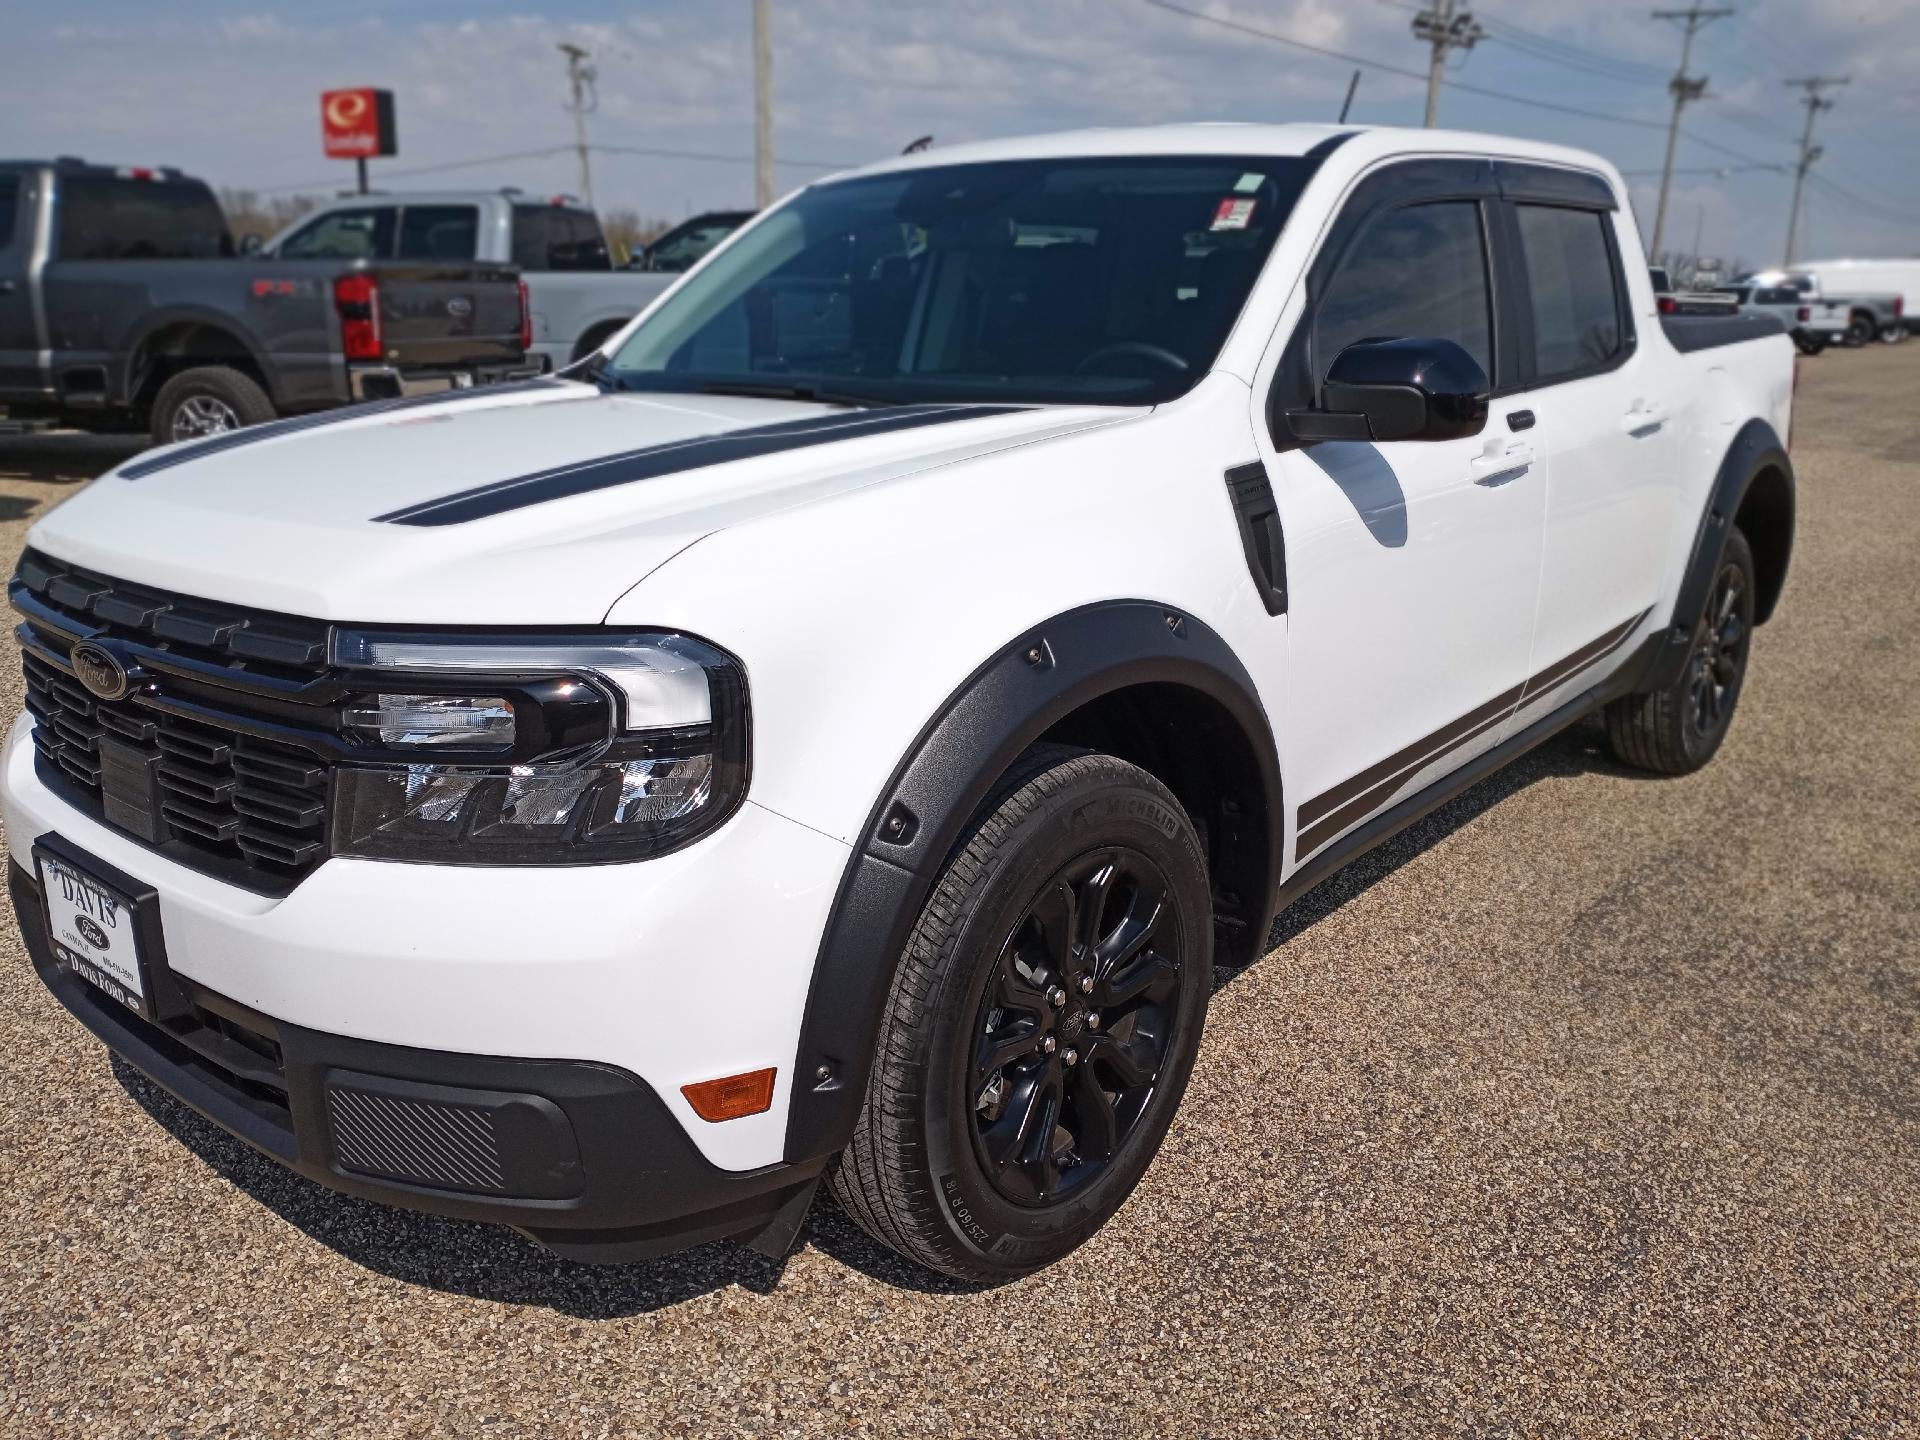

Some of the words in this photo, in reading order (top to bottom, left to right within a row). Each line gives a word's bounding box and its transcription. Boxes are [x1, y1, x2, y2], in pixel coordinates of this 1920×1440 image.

[61, 875, 117, 929] DAVIS
[81, 918, 103, 946] Ford
[69, 952, 98, 985] DAVIS
[98, 971, 125, 1004] FORD
